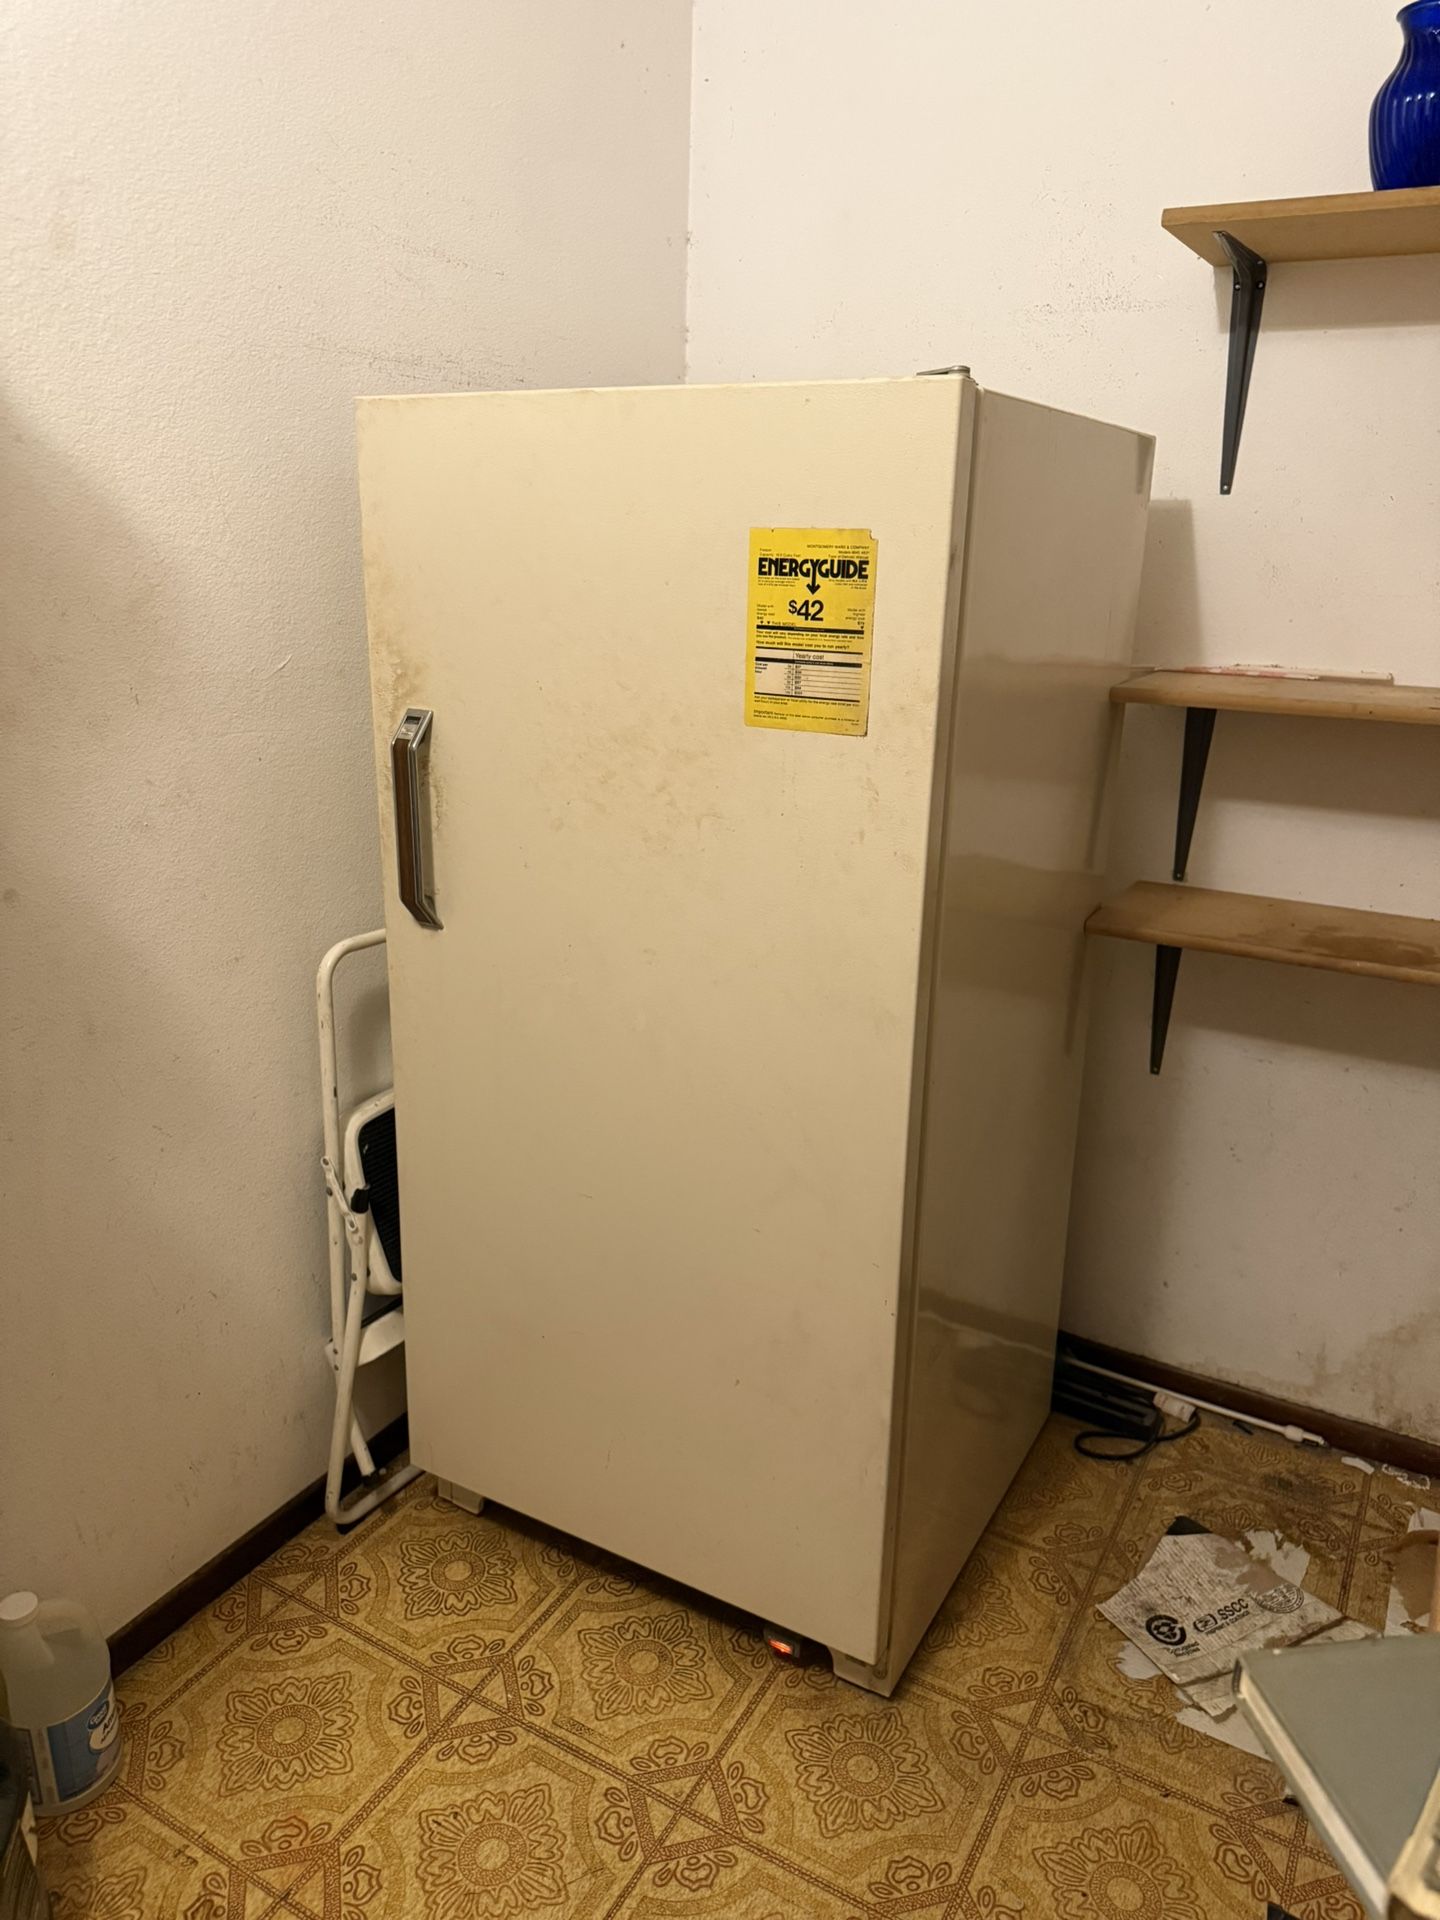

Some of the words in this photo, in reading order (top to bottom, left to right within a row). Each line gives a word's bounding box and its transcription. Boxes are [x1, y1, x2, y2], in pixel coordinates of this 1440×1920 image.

[758, 557, 869, 580] ENERGYGUIDE
[788, 599, 824, 621] $42
[1217, 1598, 1249, 1622] SSCC
